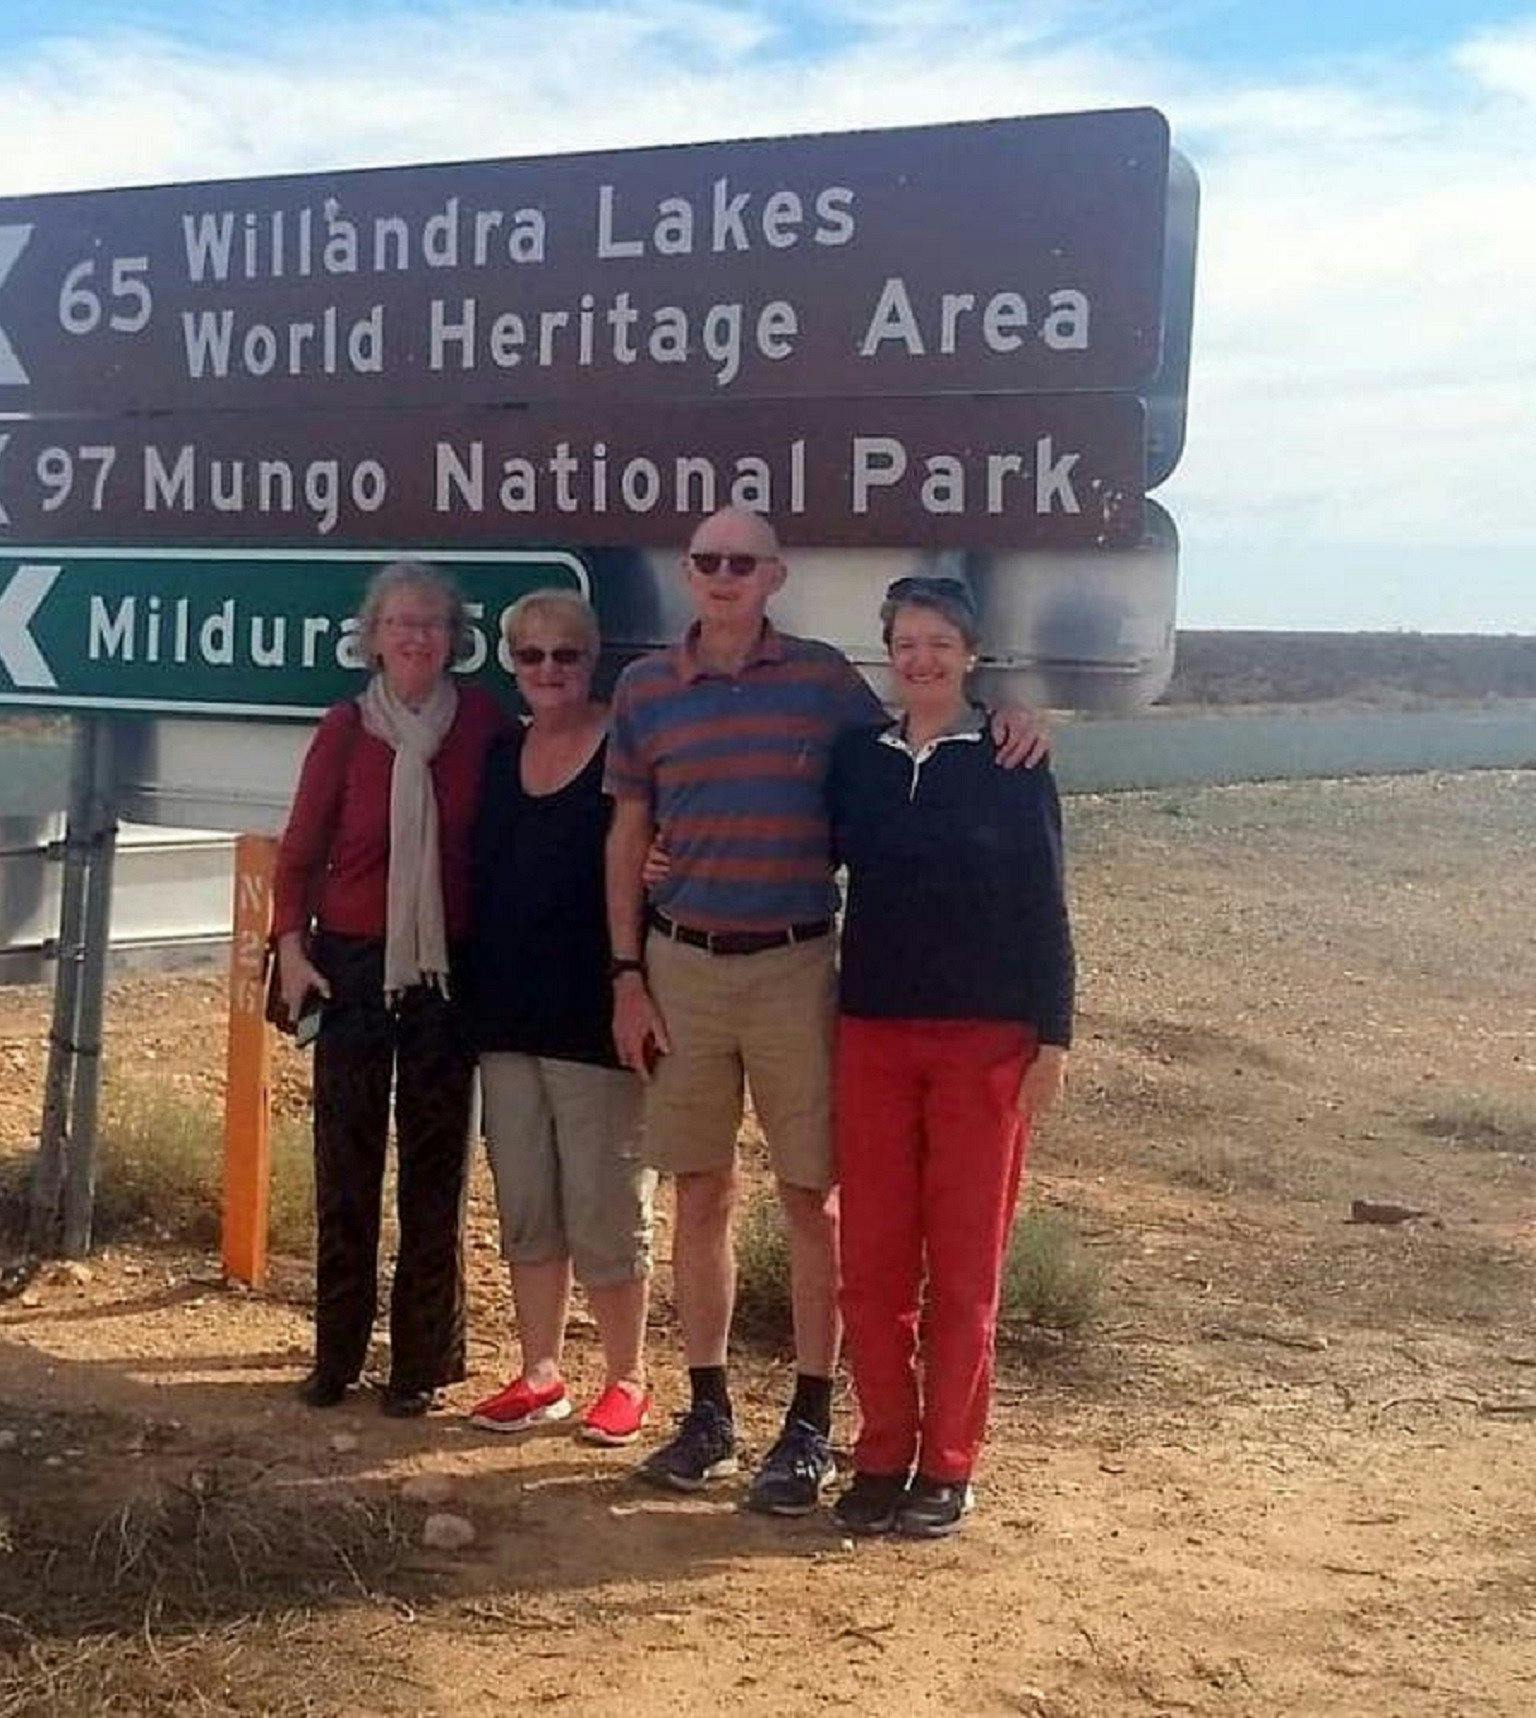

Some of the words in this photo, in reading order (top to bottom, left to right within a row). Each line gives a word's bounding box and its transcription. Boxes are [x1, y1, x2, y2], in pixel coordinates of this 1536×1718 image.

[183, 198, 546, 282] Willandra
[597, 177, 856, 259] Lakes
[59, 257, 152, 335] 65
[183, 305, 386, 379] World
[430, 292, 799, 386] Heritage
[860, 277, 1092, 357] Area
[36, 446, 117, 512] 97
[144, 444, 388, 535] Mungo
[435, 439, 807, 514] National
[852, 435, 1083, 515] Park
[87, 594, 370, 668] Mildura
